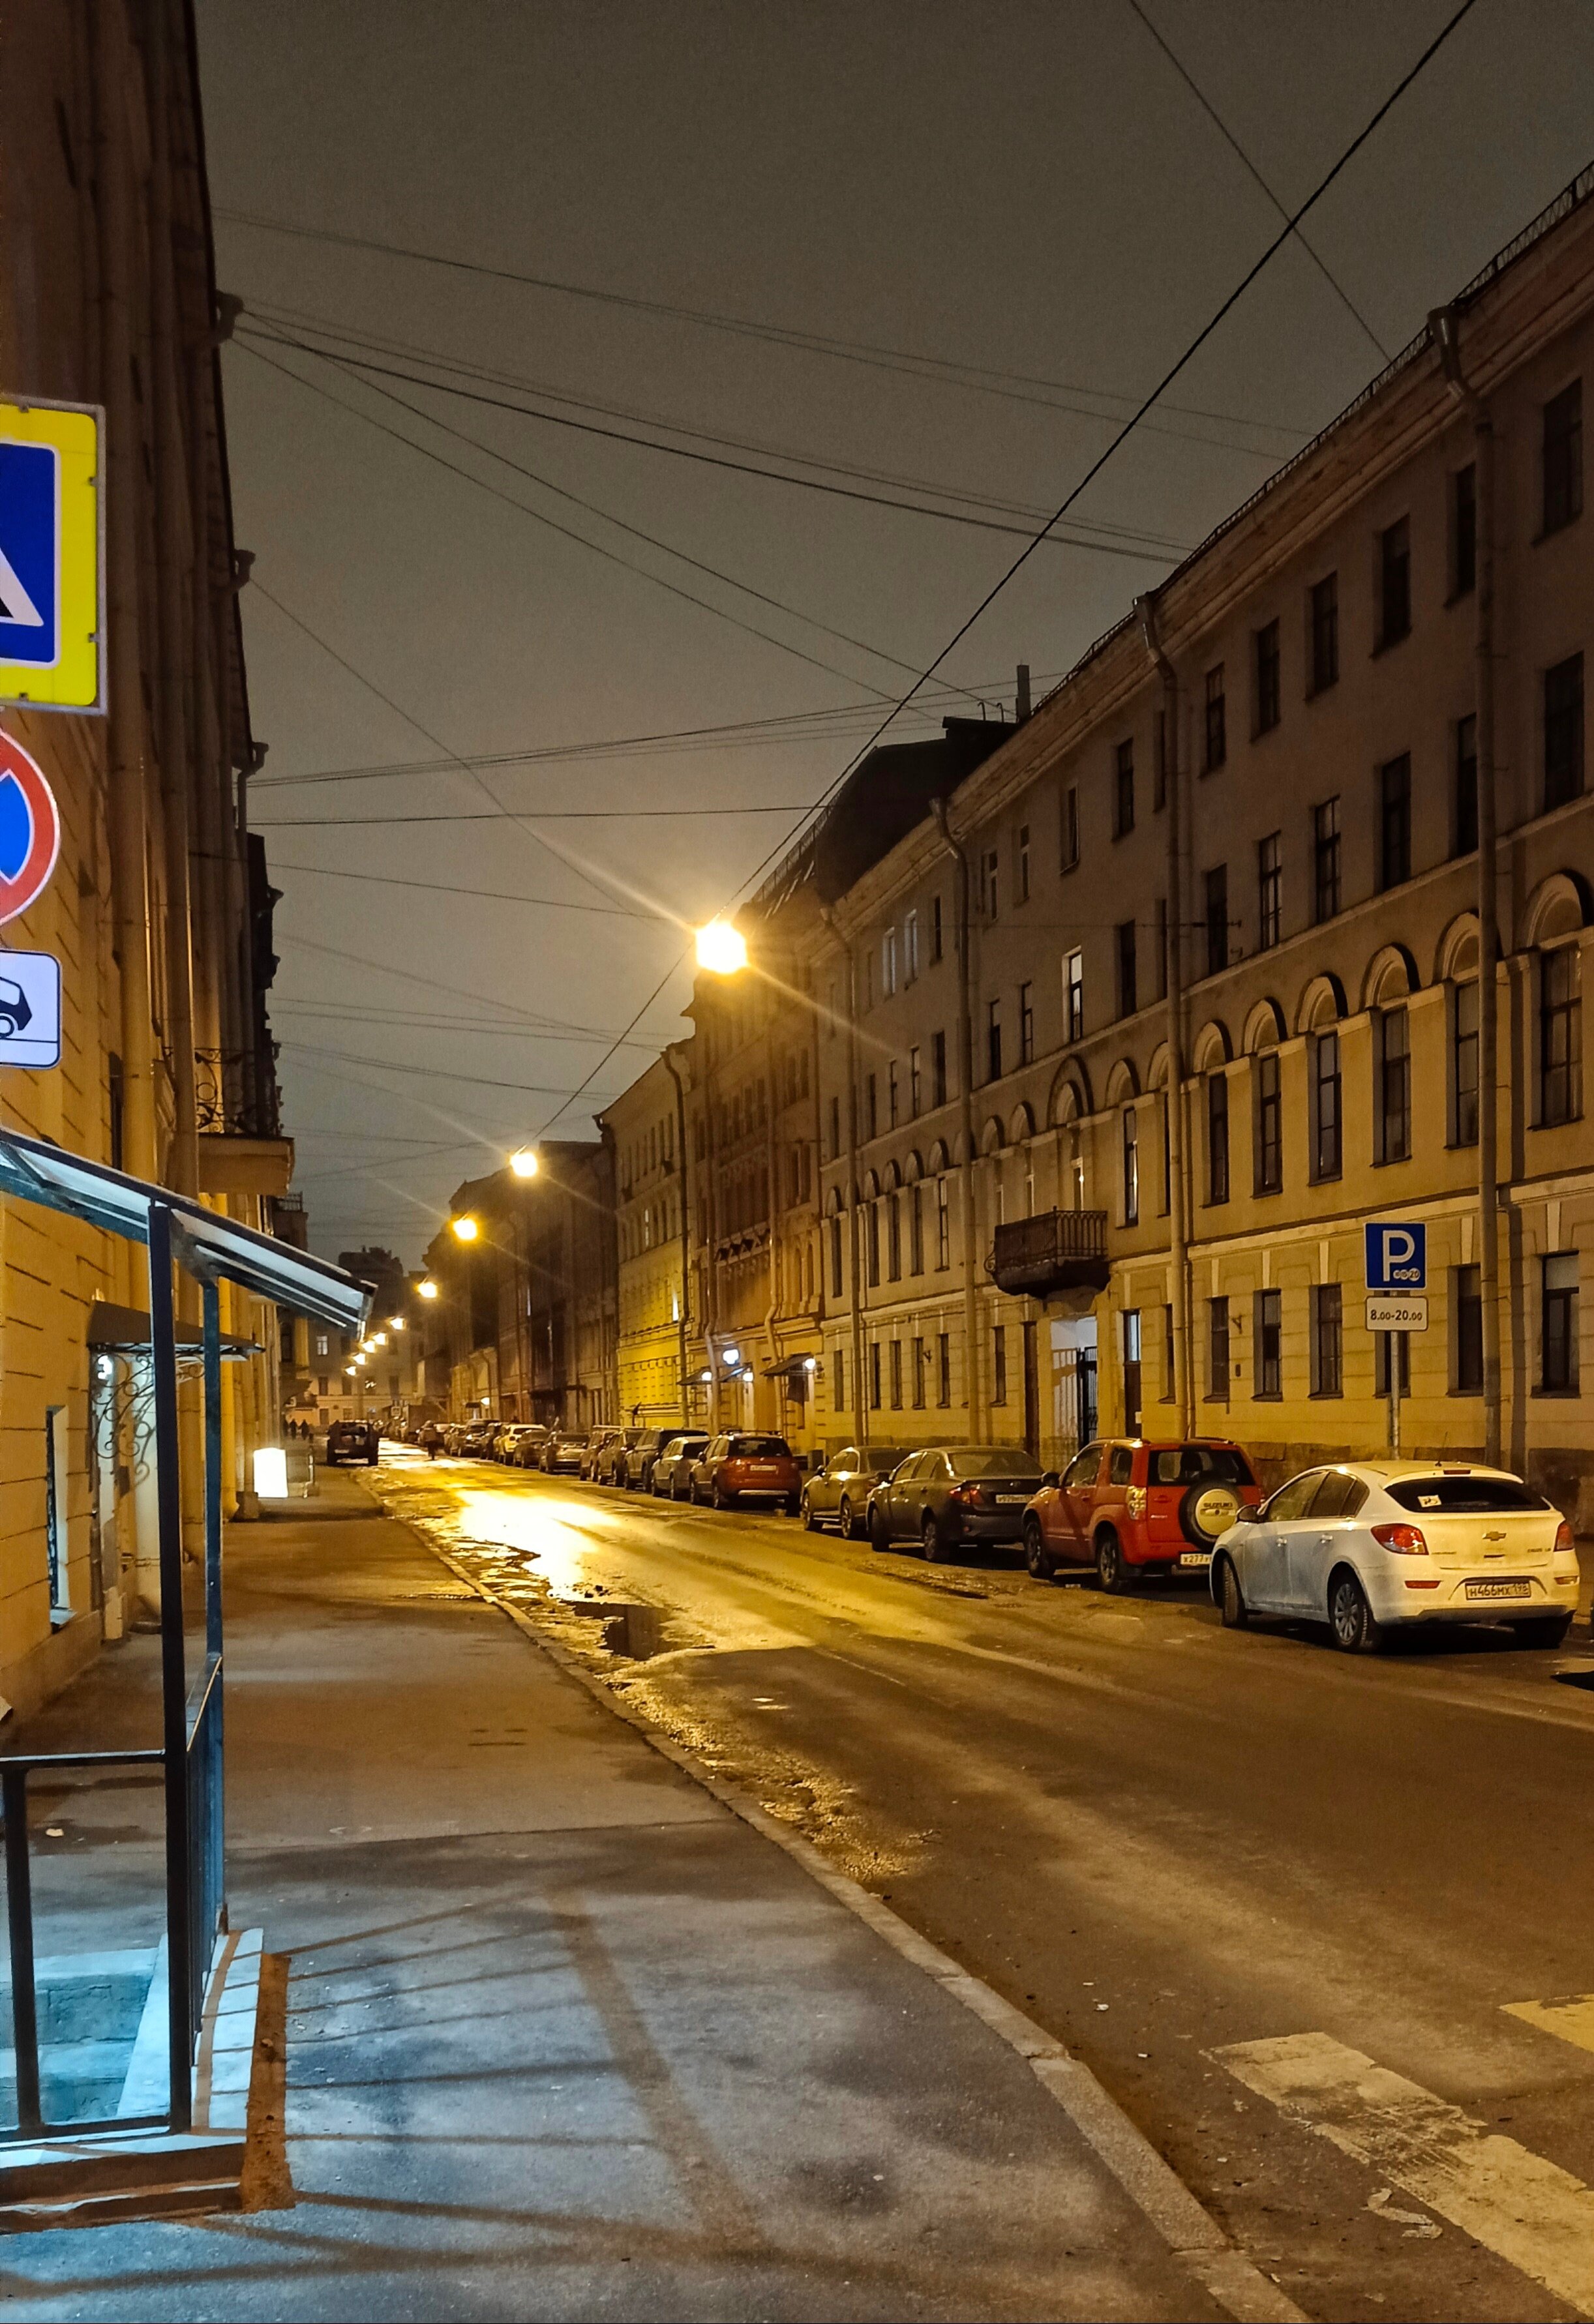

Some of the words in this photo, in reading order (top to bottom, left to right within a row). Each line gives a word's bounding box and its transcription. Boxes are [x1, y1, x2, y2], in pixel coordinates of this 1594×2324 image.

[1383, 1230, 1415, 1281] P
[1409, 1270, 1420, 1279] 20
[1370, 1309, 1422, 1321] 8.00-20.00
